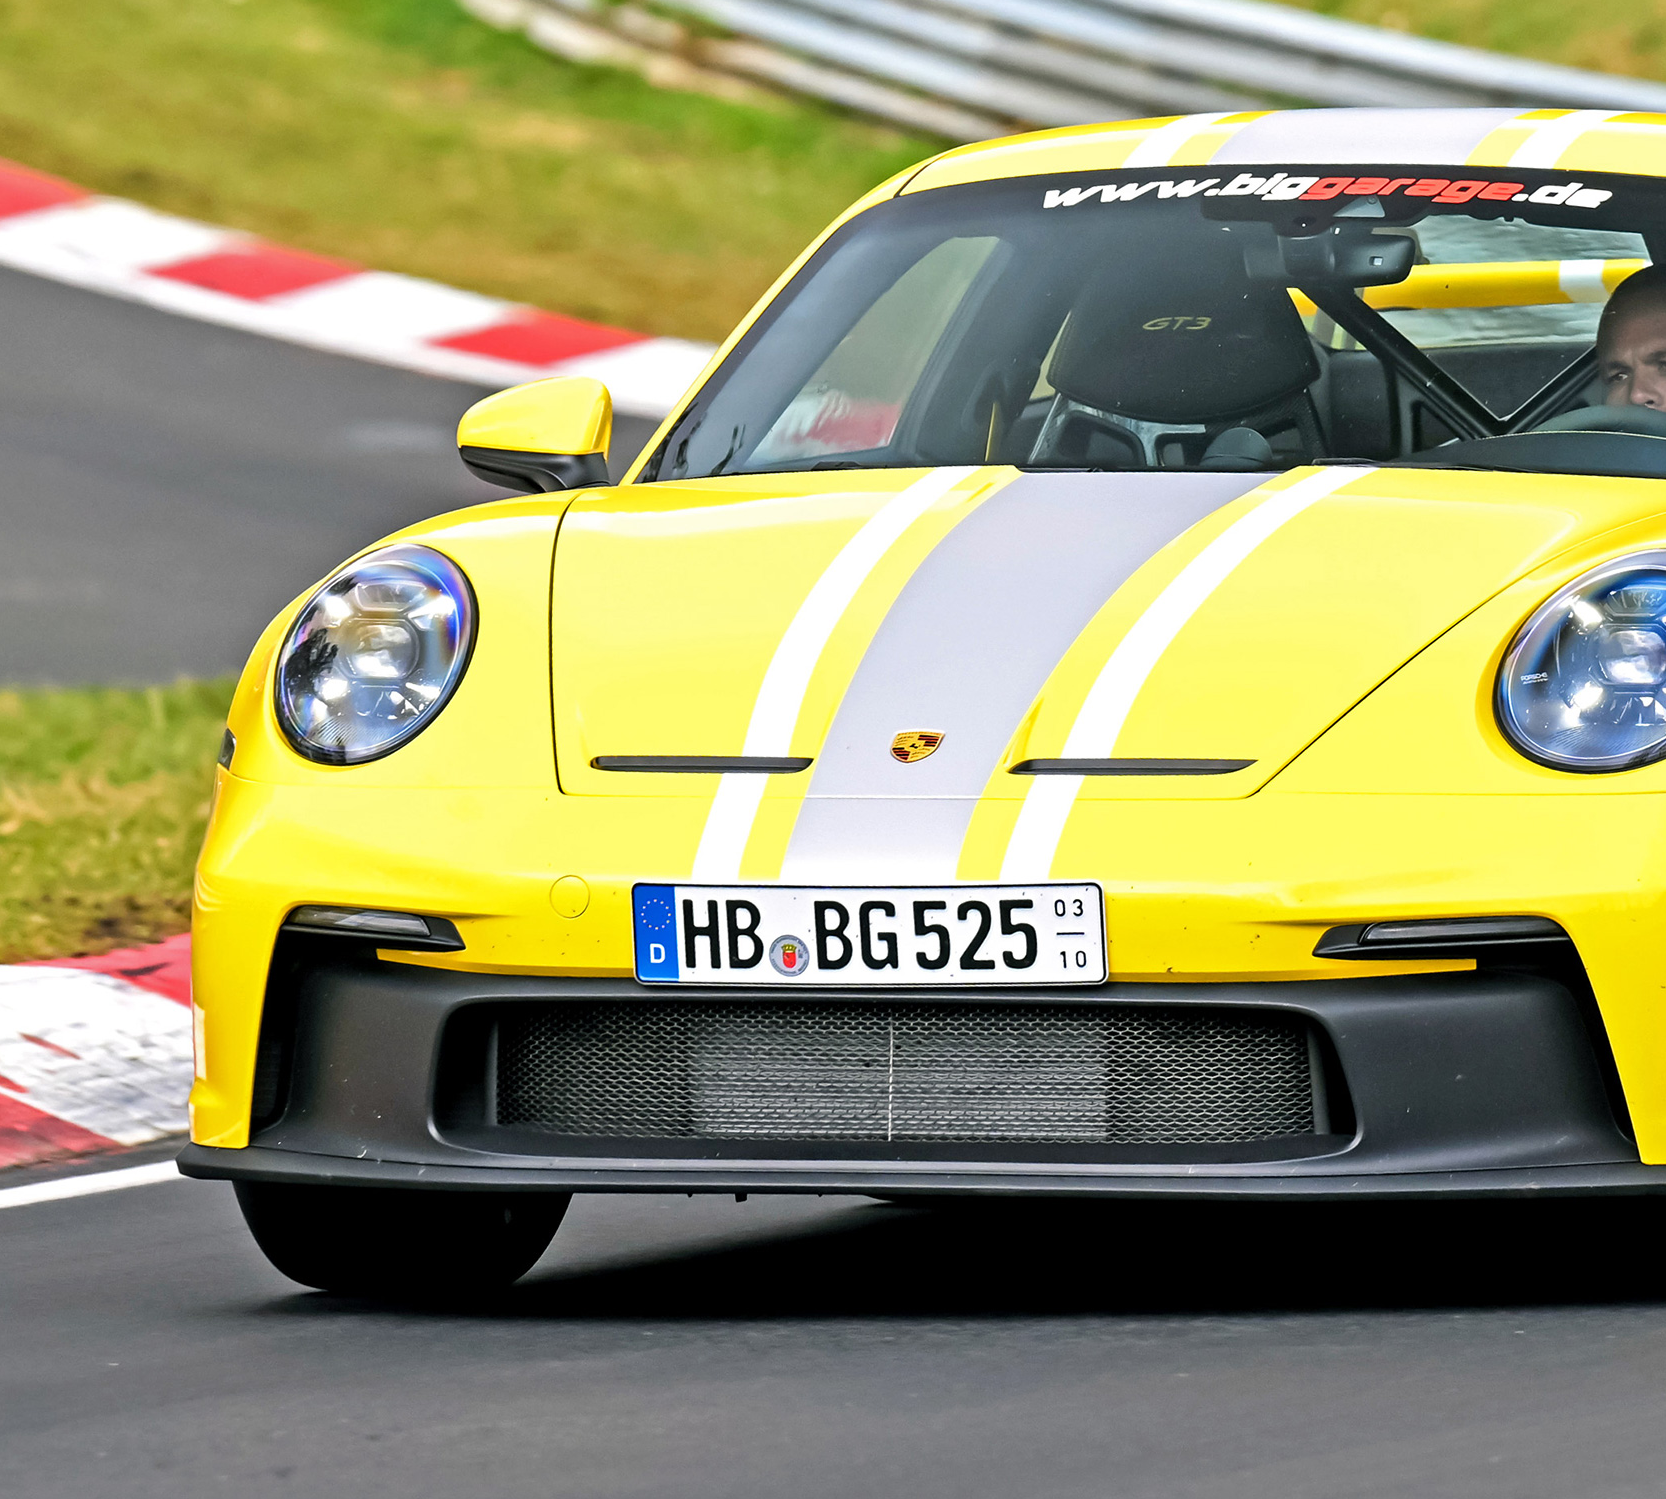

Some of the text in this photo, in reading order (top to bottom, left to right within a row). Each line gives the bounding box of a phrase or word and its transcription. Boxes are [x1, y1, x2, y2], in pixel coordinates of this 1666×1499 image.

[1042, 172, 1613, 209] www.biggarage.de
[1142, 316, 1212, 331] GT3
[1054, 898, 1084, 918] 03
[682, 898, 765, 970] HB
[649, 943, 666, 964] D
[1060, 950, 1087, 969] 10
